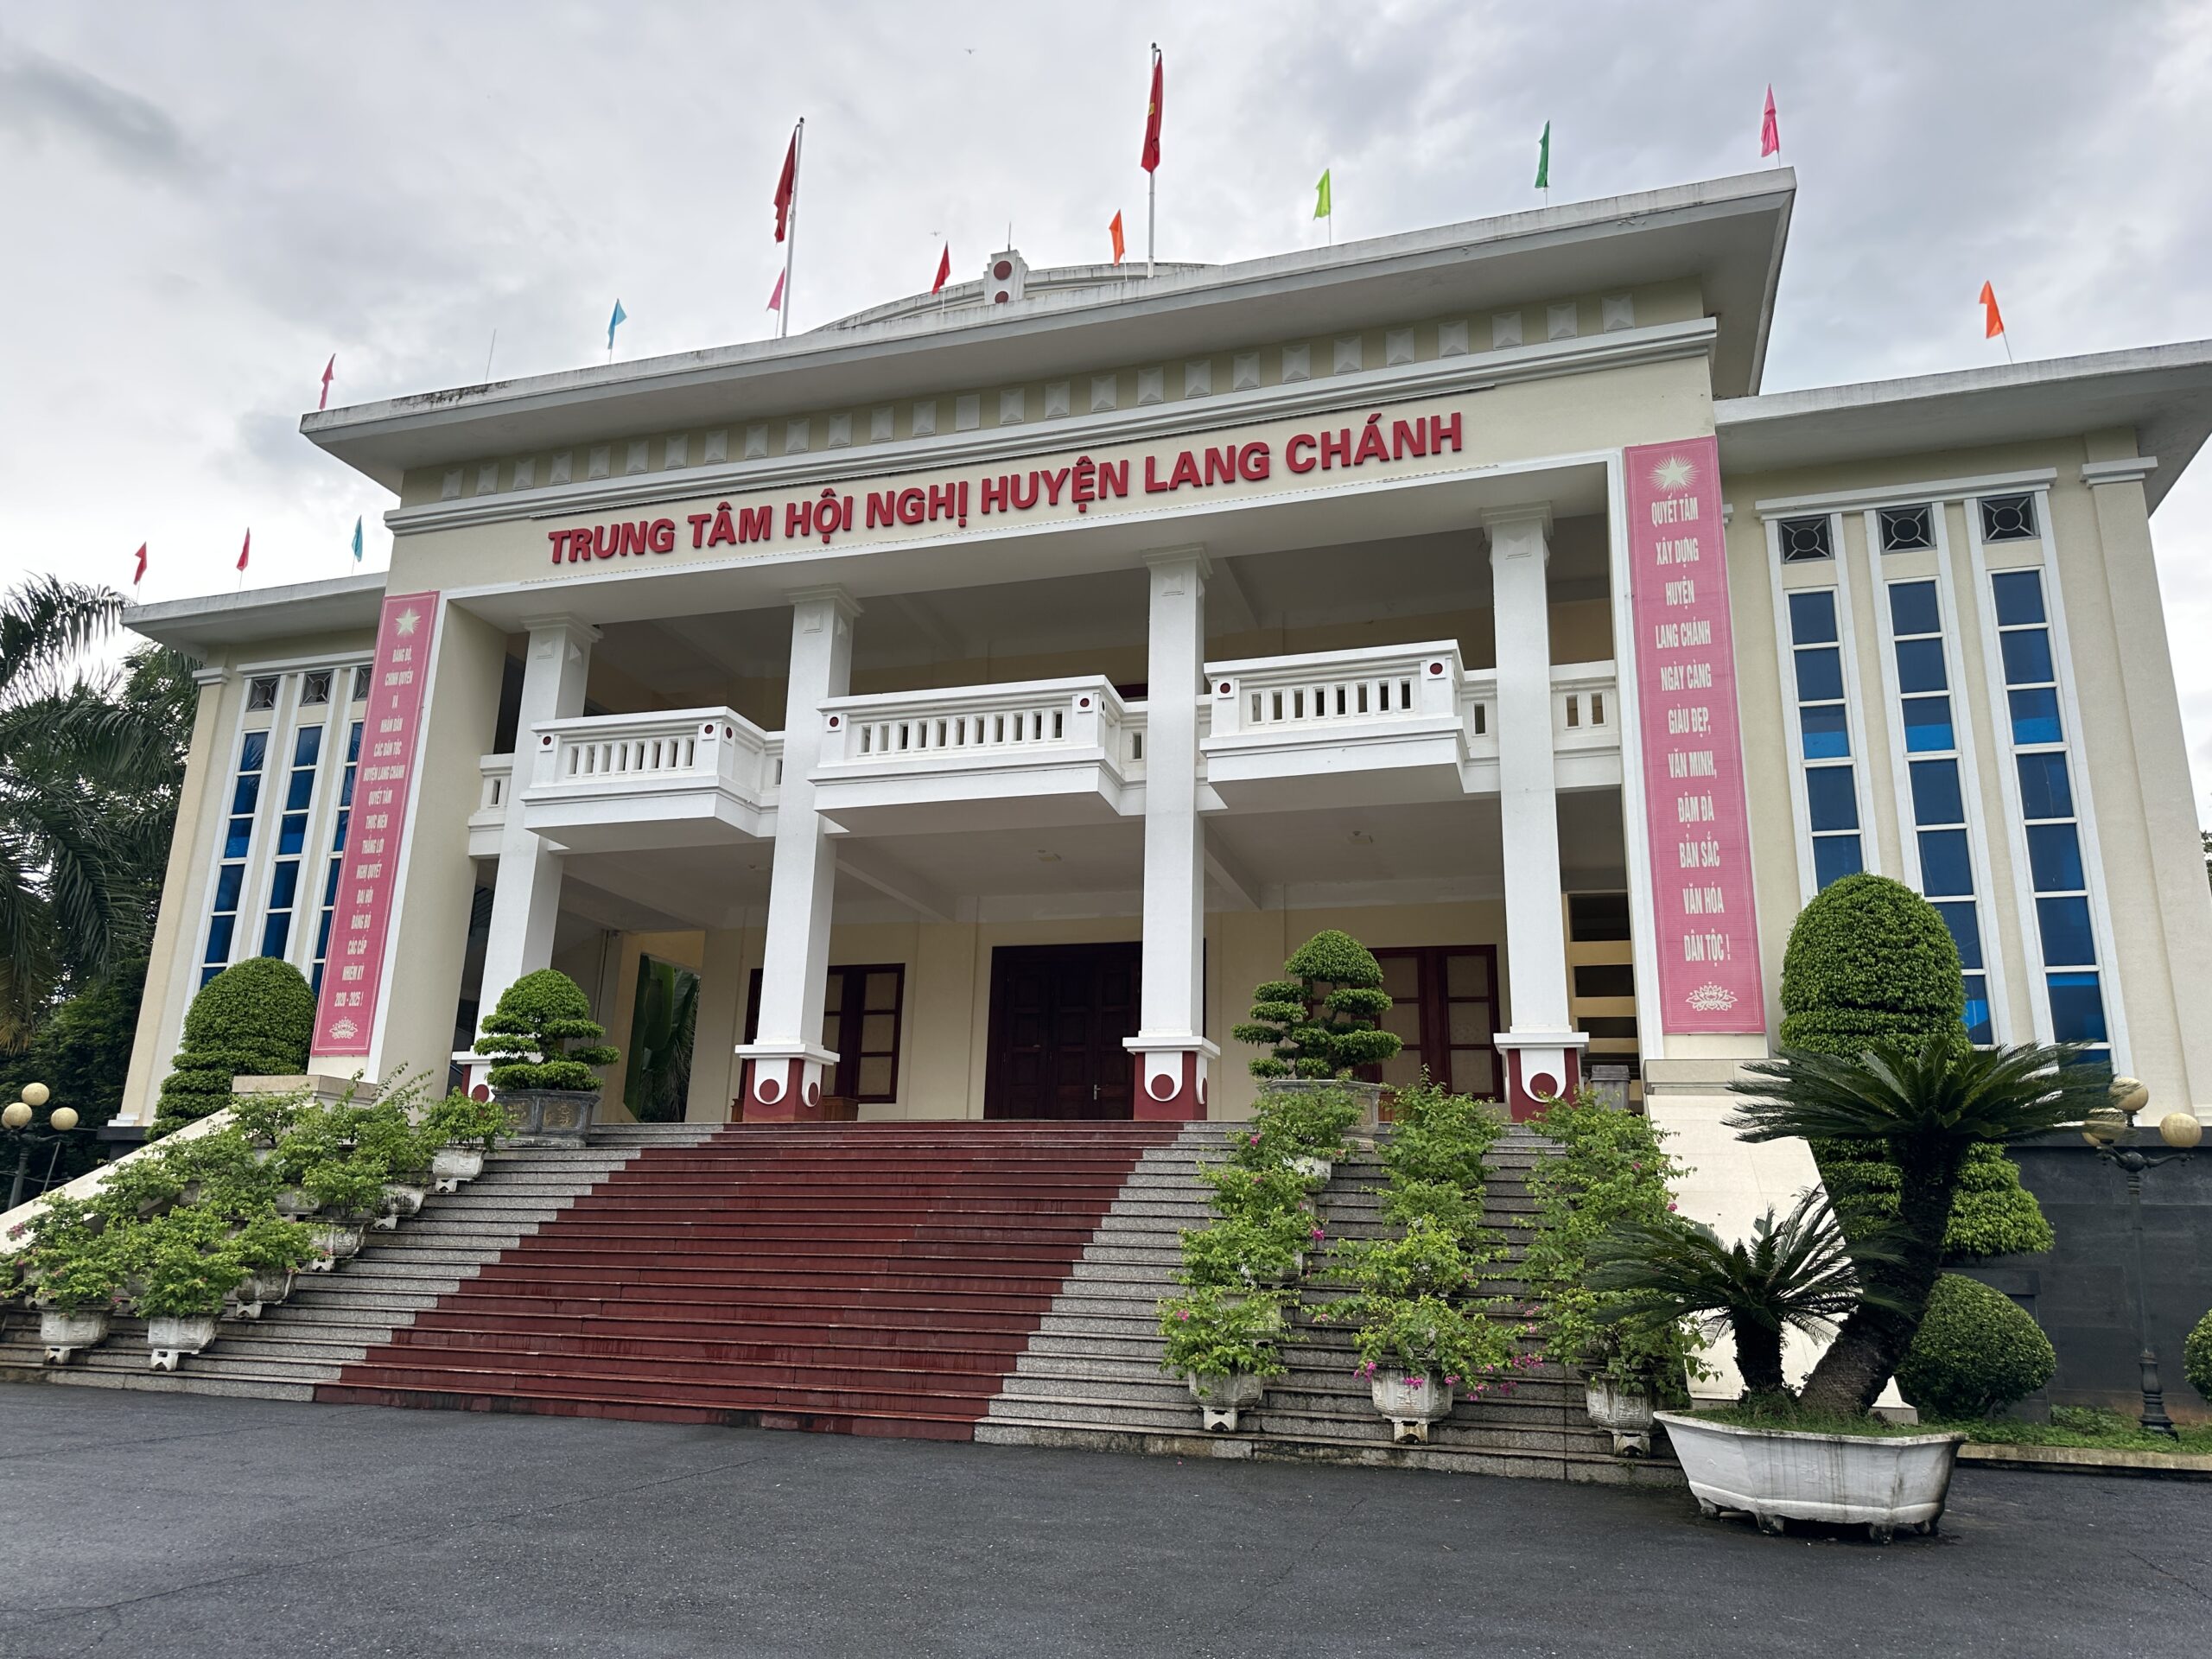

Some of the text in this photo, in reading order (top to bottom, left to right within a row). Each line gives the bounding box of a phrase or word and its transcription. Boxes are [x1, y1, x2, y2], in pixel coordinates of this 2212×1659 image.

[548, 412, 1462, 563] TRUNG TÂM HỘI NGHỊ HUYỆN LANG CHÁNH
[1651, 493, 1699, 527] QUYẾT TÂM
[1656, 537, 1700, 568] XÂY DỰNG
[1665, 575, 1694, 609] HUYỆN
[1655, 617, 1711, 649] LANG CHÁNH
[1660, 659, 1712, 691] NGÀY CÀNG
[1668, 706, 1711, 738] GIÀU ĐẸP,
[373, 741, 384, 758] CÁC
[393, 738, 403, 759] TỘC
[1668, 747, 1718, 779] VĂN MINH,
[363, 762, 406, 785] HUYỆN LANG CHÁNH
[368, 786, 393, 807] QUYẾT TÂM
[1677, 790, 1714, 829] ĐẬM ĐÀ
[377, 811, 389, 832] HIỆN
[1679, 831, 1720, 868] BẢN SẮC
[367, 859, 382, 880] QUYẾT
[1682, 881, 1725, 915] VĂN HÓA
[347, 934, 367, 955] CÁC CẤP
[1684, 928, 1731, 967] DÂN TỘC !
[342, 962, 358, 984] NHIỆM
[334, 991, 346, 1007] 2020
[348, 991, 361, 1007] 2025
